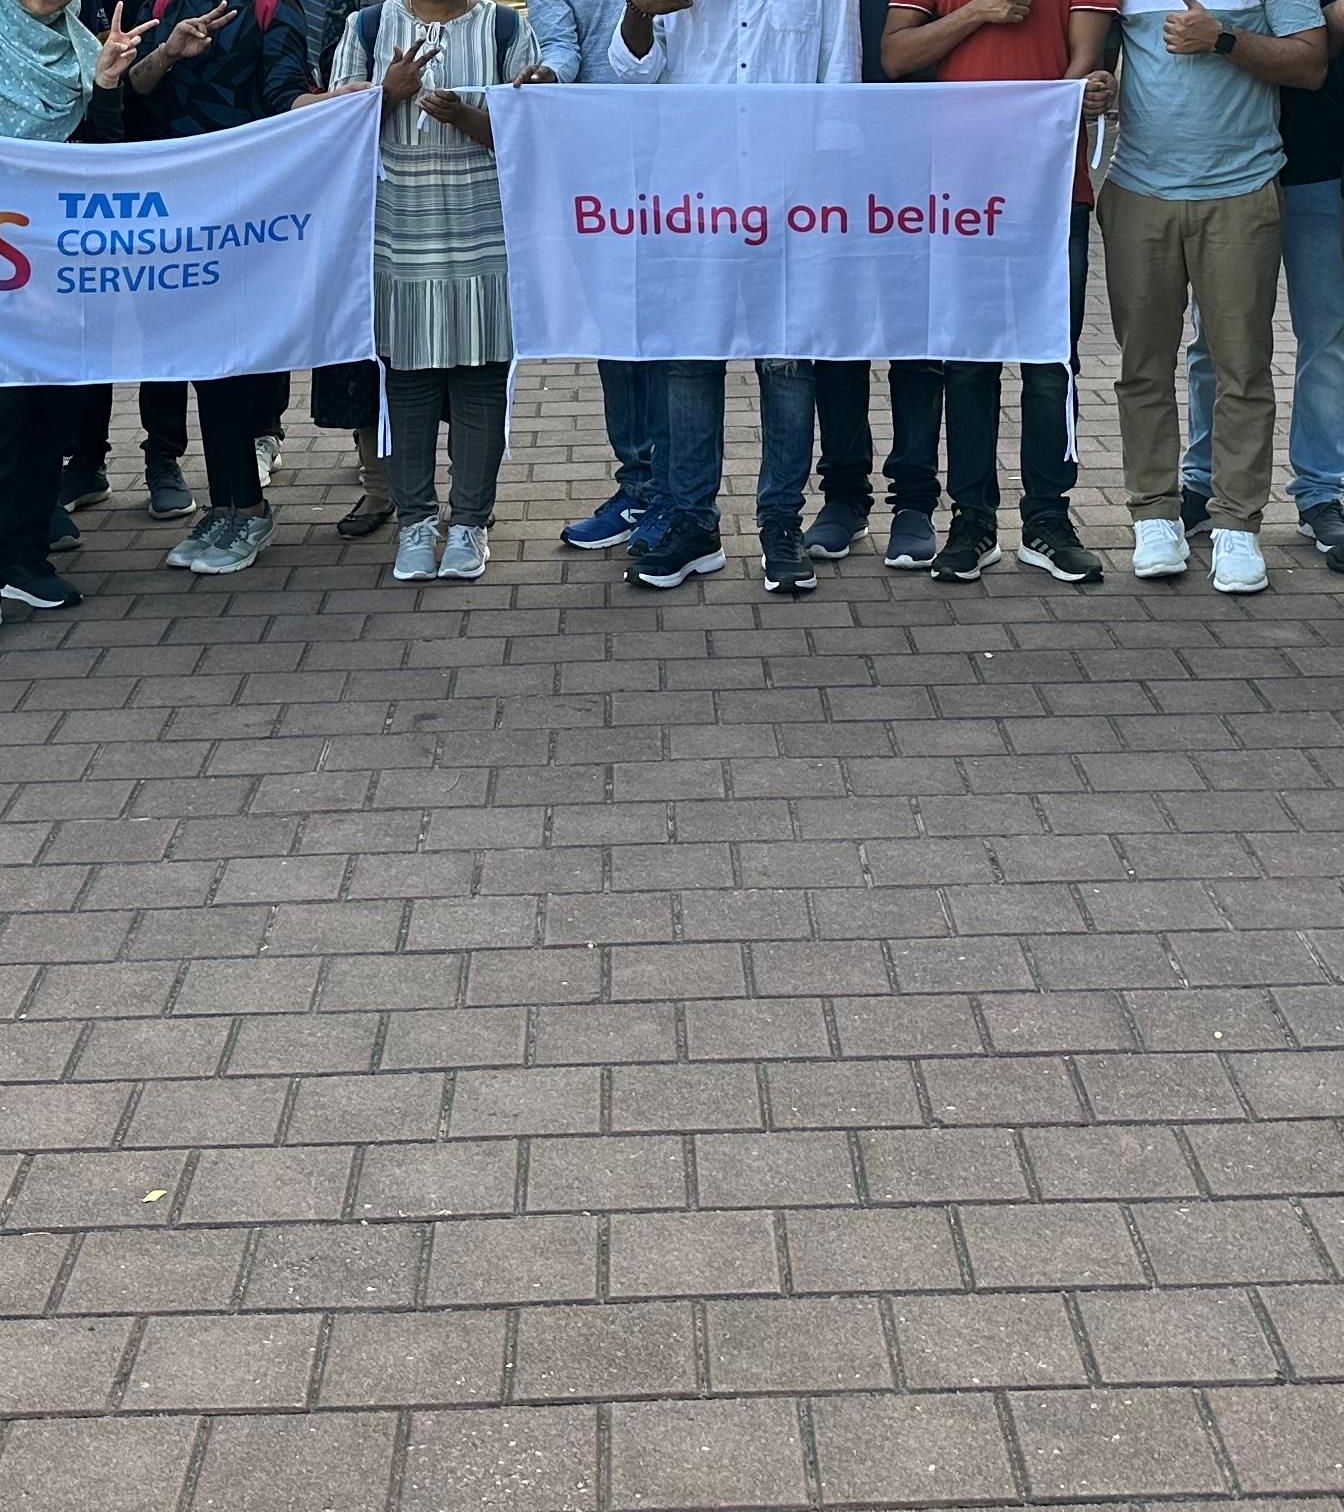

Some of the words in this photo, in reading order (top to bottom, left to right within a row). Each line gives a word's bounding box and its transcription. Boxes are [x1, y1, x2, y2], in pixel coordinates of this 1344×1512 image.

[58, 190, 169, 219] TATA
[574, 191, 769, 247] Building
[787, 204, 848, 234] on
[868, 193, 1006, 236] belief
[57, 213, 312, 256] CONSULTANCY
[57, 260, 221, 294] SERVICES
